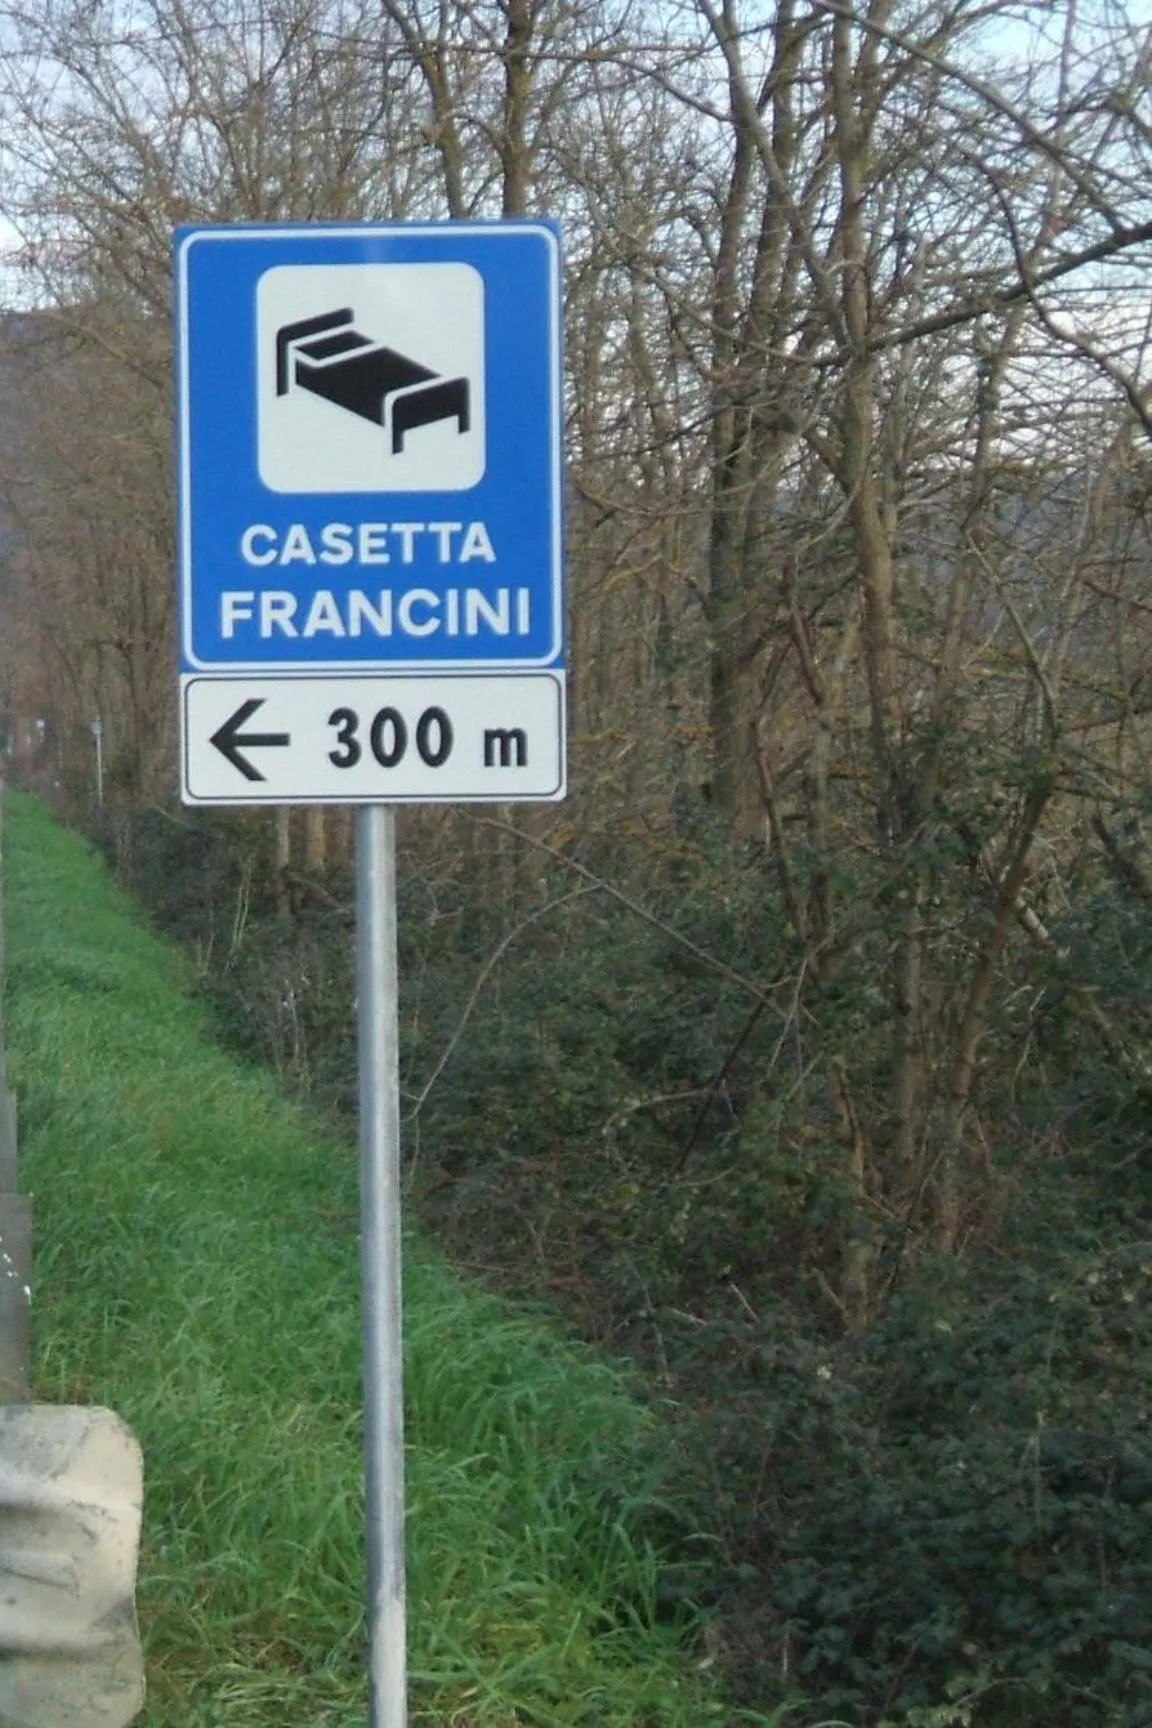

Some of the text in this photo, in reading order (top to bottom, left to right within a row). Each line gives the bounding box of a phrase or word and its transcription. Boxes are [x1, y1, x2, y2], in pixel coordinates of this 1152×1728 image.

[241, 522, 496, 566] CASETTA
[220, 588, 531, 638] FRANCINI
[327, 706, 528, 769] 300 m
